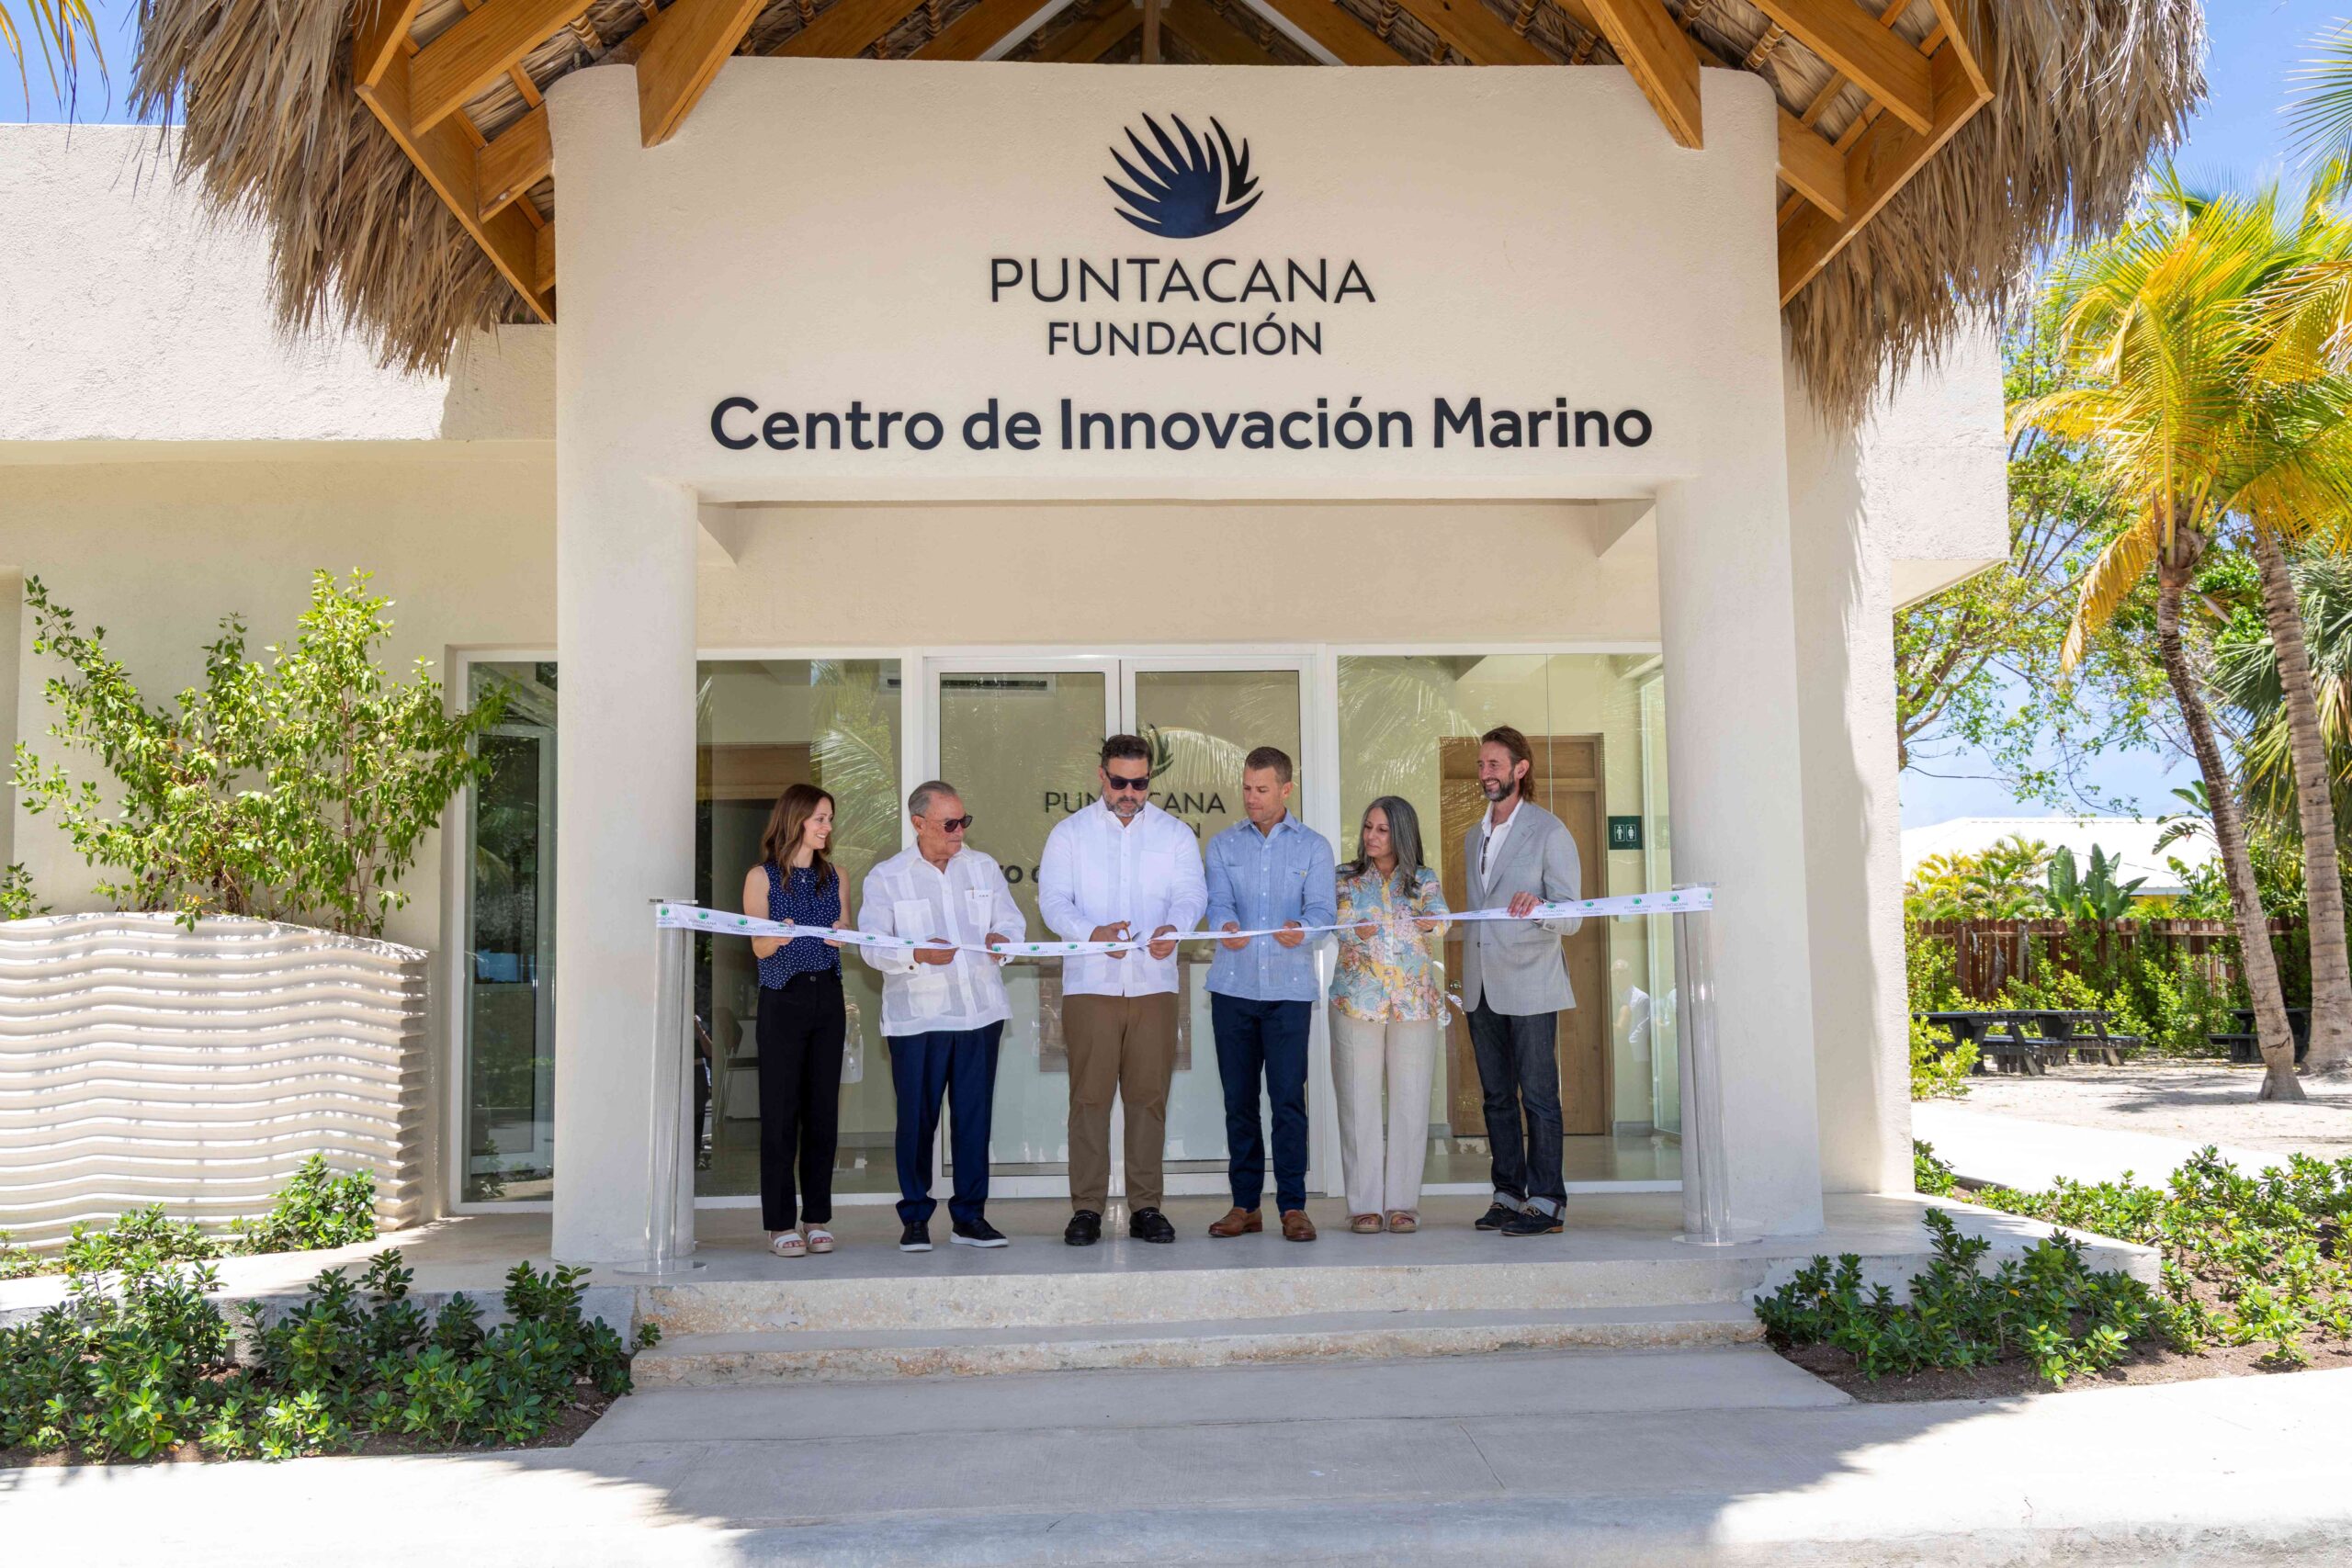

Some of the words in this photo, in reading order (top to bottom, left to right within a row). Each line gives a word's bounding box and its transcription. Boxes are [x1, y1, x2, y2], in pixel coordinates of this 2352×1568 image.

[990, 256, 1376, 304] PUNTACANA
[1047, 311, 1321, 356] FUNDACIÓN
[709, 396, 945, 451] Centro
[961, 397, 1043, 451] de
[1059, 396, 1414, 450] Innovación
[1432, 397, 1653, 448] Marino
